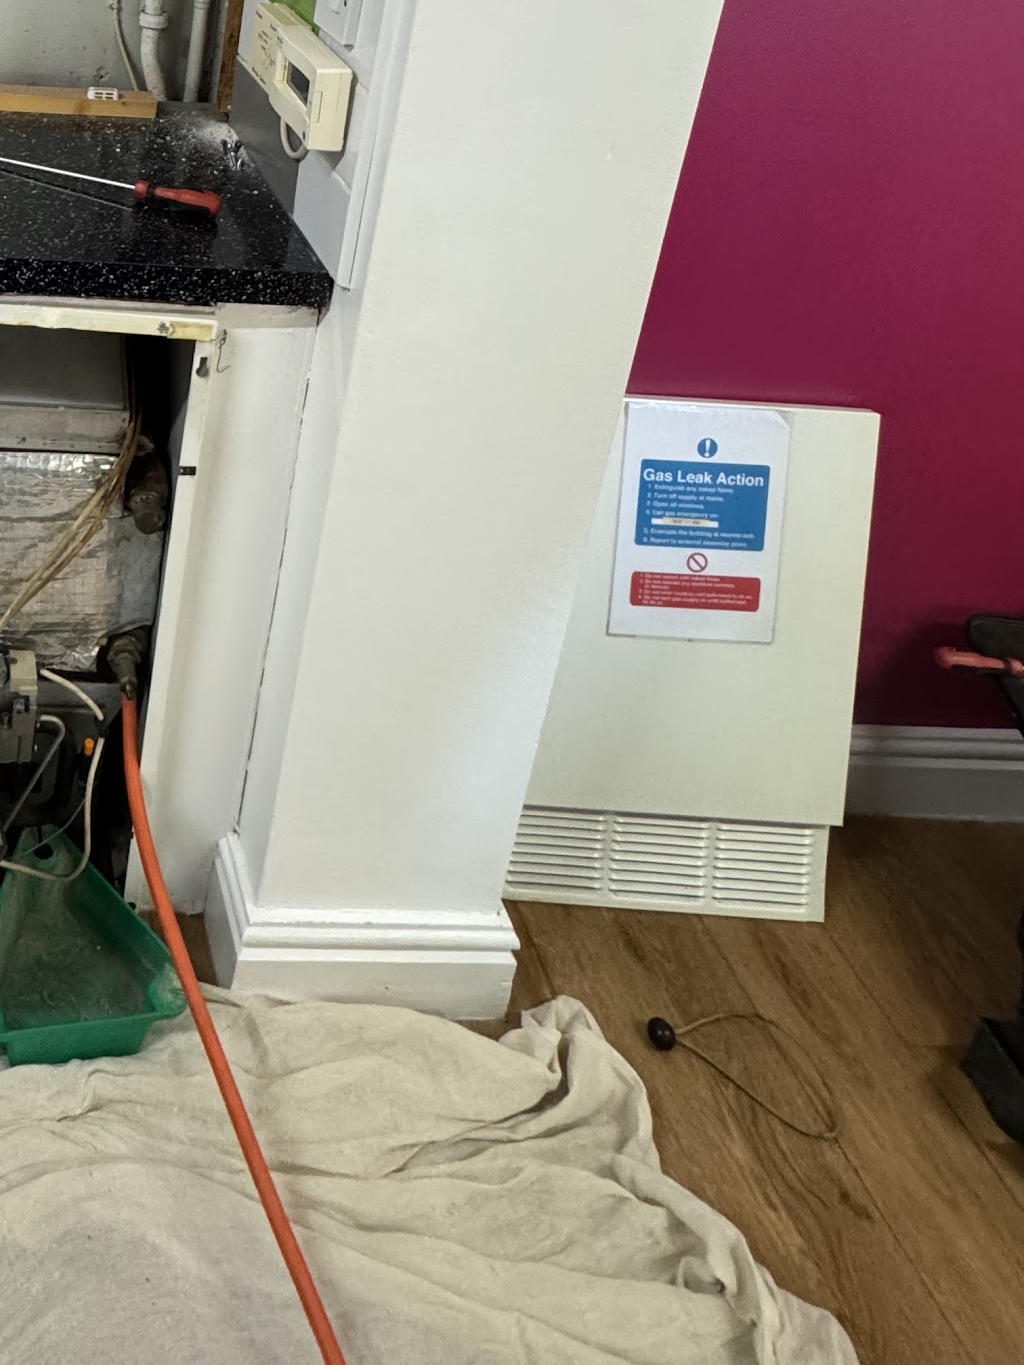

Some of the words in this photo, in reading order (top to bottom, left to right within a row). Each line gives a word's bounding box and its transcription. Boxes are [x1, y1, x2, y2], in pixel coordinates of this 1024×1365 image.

[643, 468, 673, 482] Gas
[678, 470, 712, 484] Leak
[716, 472, 764, 487] Action
